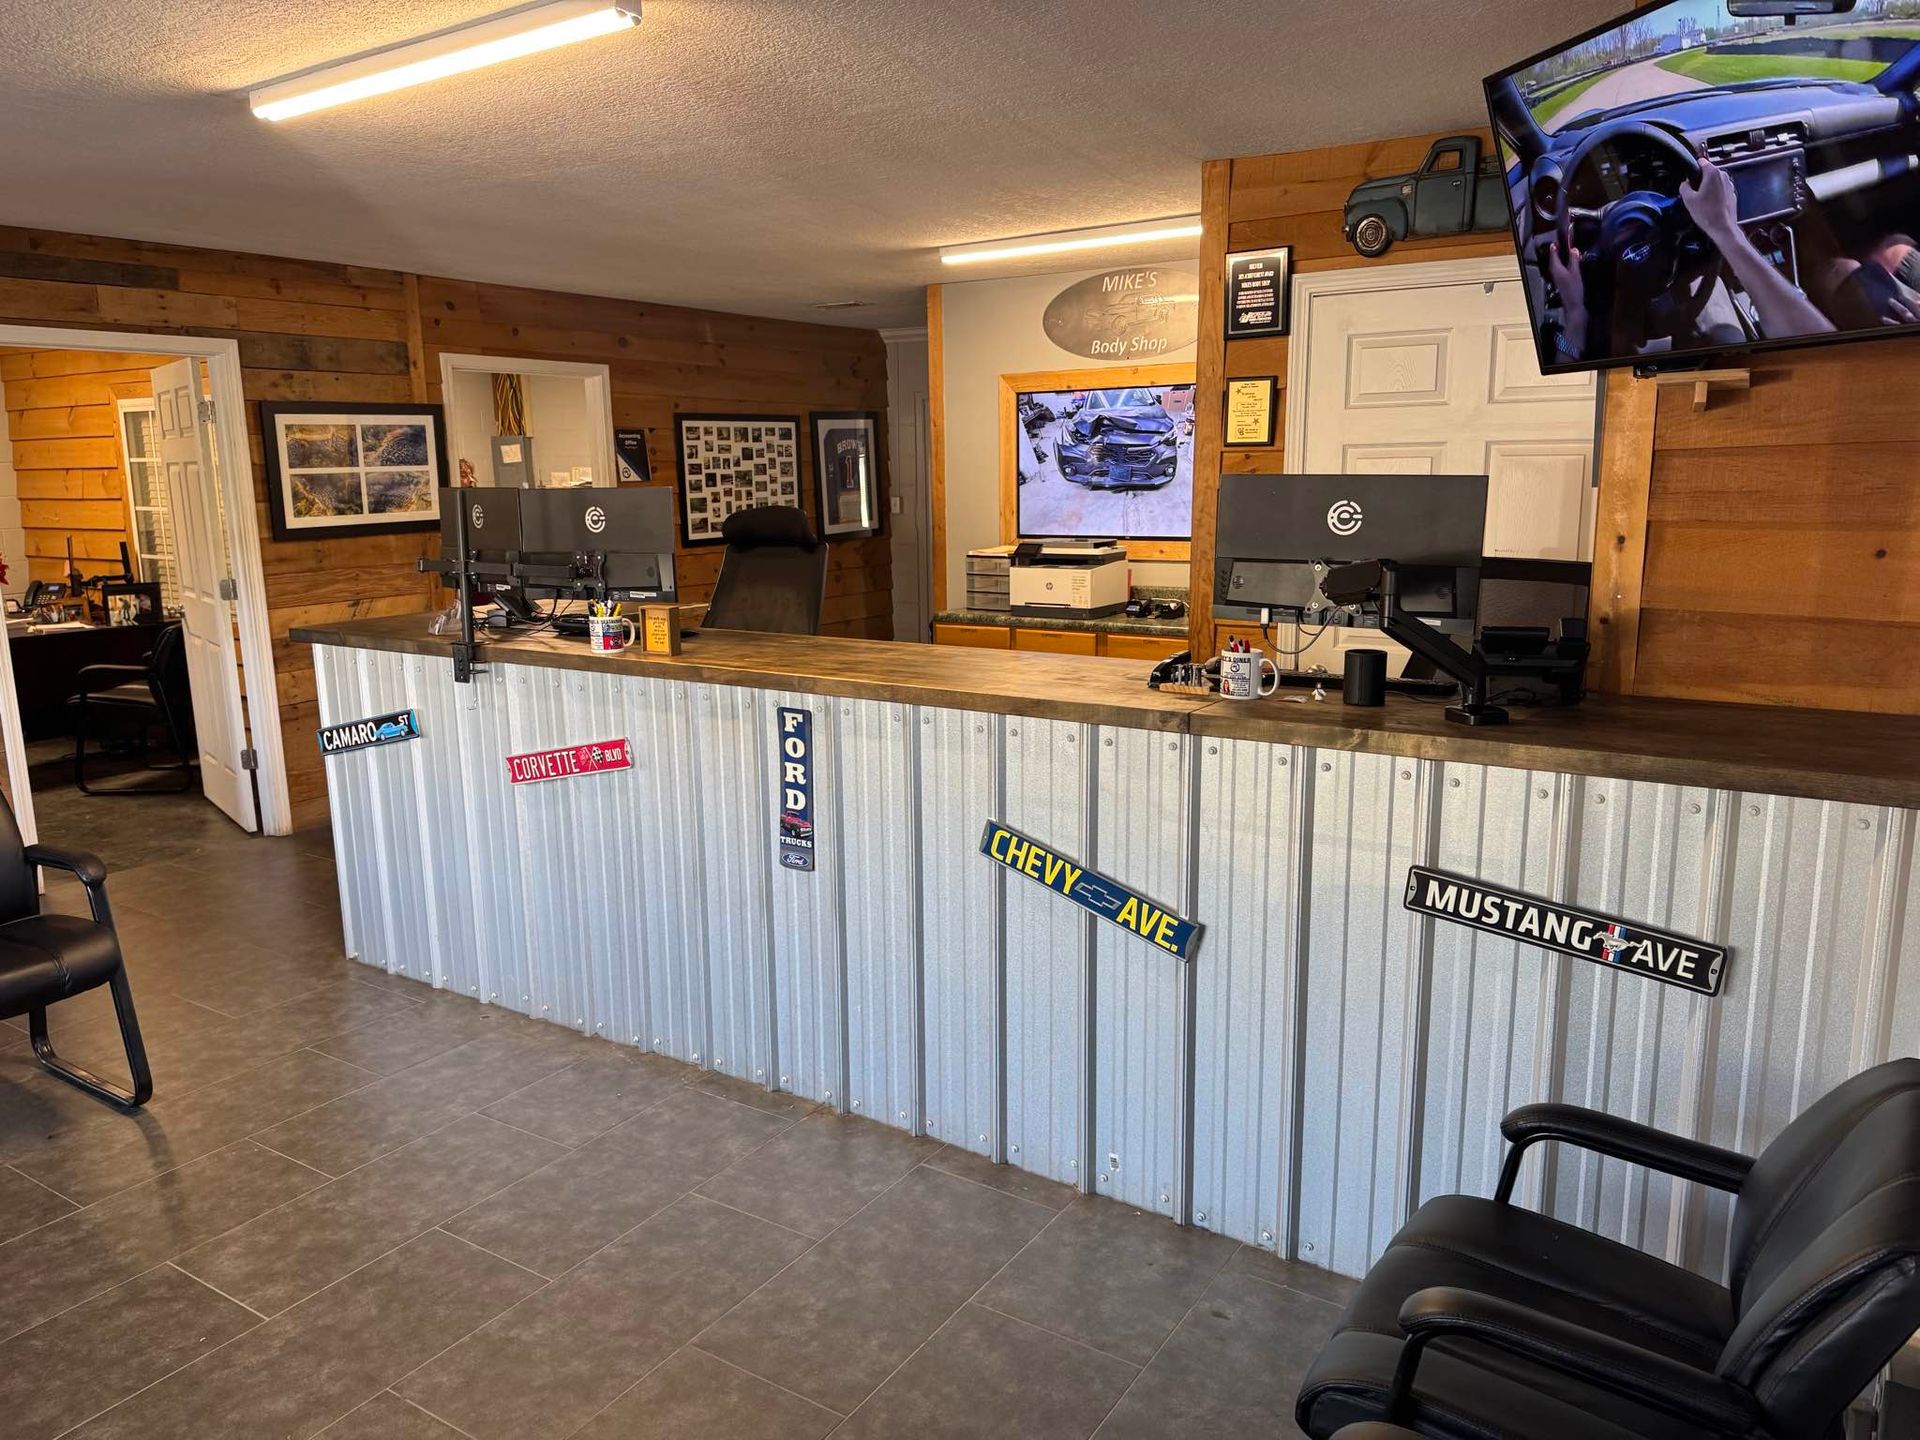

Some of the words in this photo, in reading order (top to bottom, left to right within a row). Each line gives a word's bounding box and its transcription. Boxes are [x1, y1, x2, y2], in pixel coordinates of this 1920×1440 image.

[1101, 271, 1158, 293] MIKE'S
[1090, 337, 1127, 356] Body
[1130, 335, 1168, 353] Shop
[323, 721, 377, 750] CAMARO
[397, 714, 409, 726] ST
[513, 750, 580, 781] CORVETTE
[604, 747, 622, 762] BLVD
[783, 711, 807, 811] FORD
[780, 835, 812, 848] TRUCKS
[785, 853, 804, 866] Ford
[990, 829, 1083, 895] CHEVY
[1116, 896, 1180, 953] AVE.
[1424, 879, 1595, 951] MUSTANG
[1631, 940, 1699, 980] AVE
